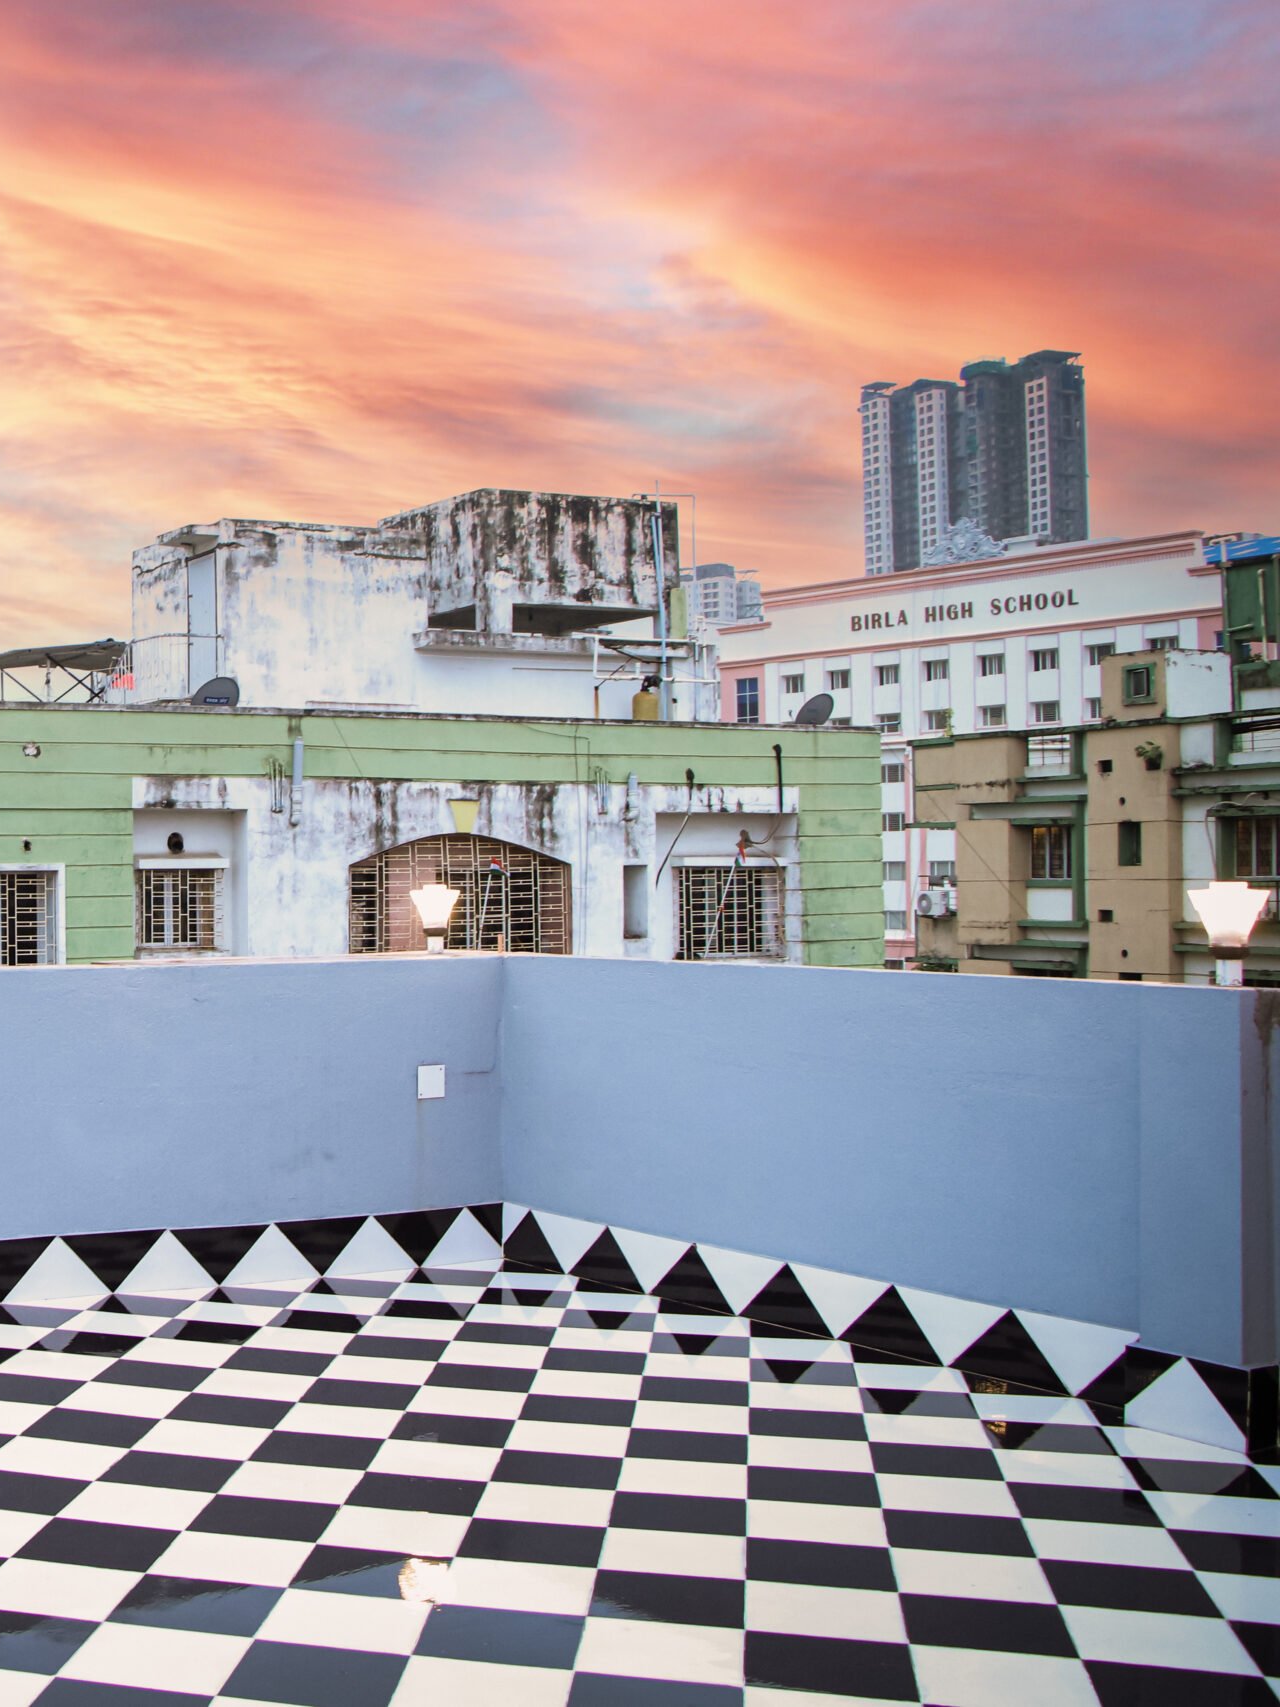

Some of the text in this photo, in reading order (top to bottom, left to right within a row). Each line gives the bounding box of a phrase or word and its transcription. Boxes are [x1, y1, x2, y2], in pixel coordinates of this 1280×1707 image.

[850, 588, 1080, 632] BIRLA HIGH SCHOOL
